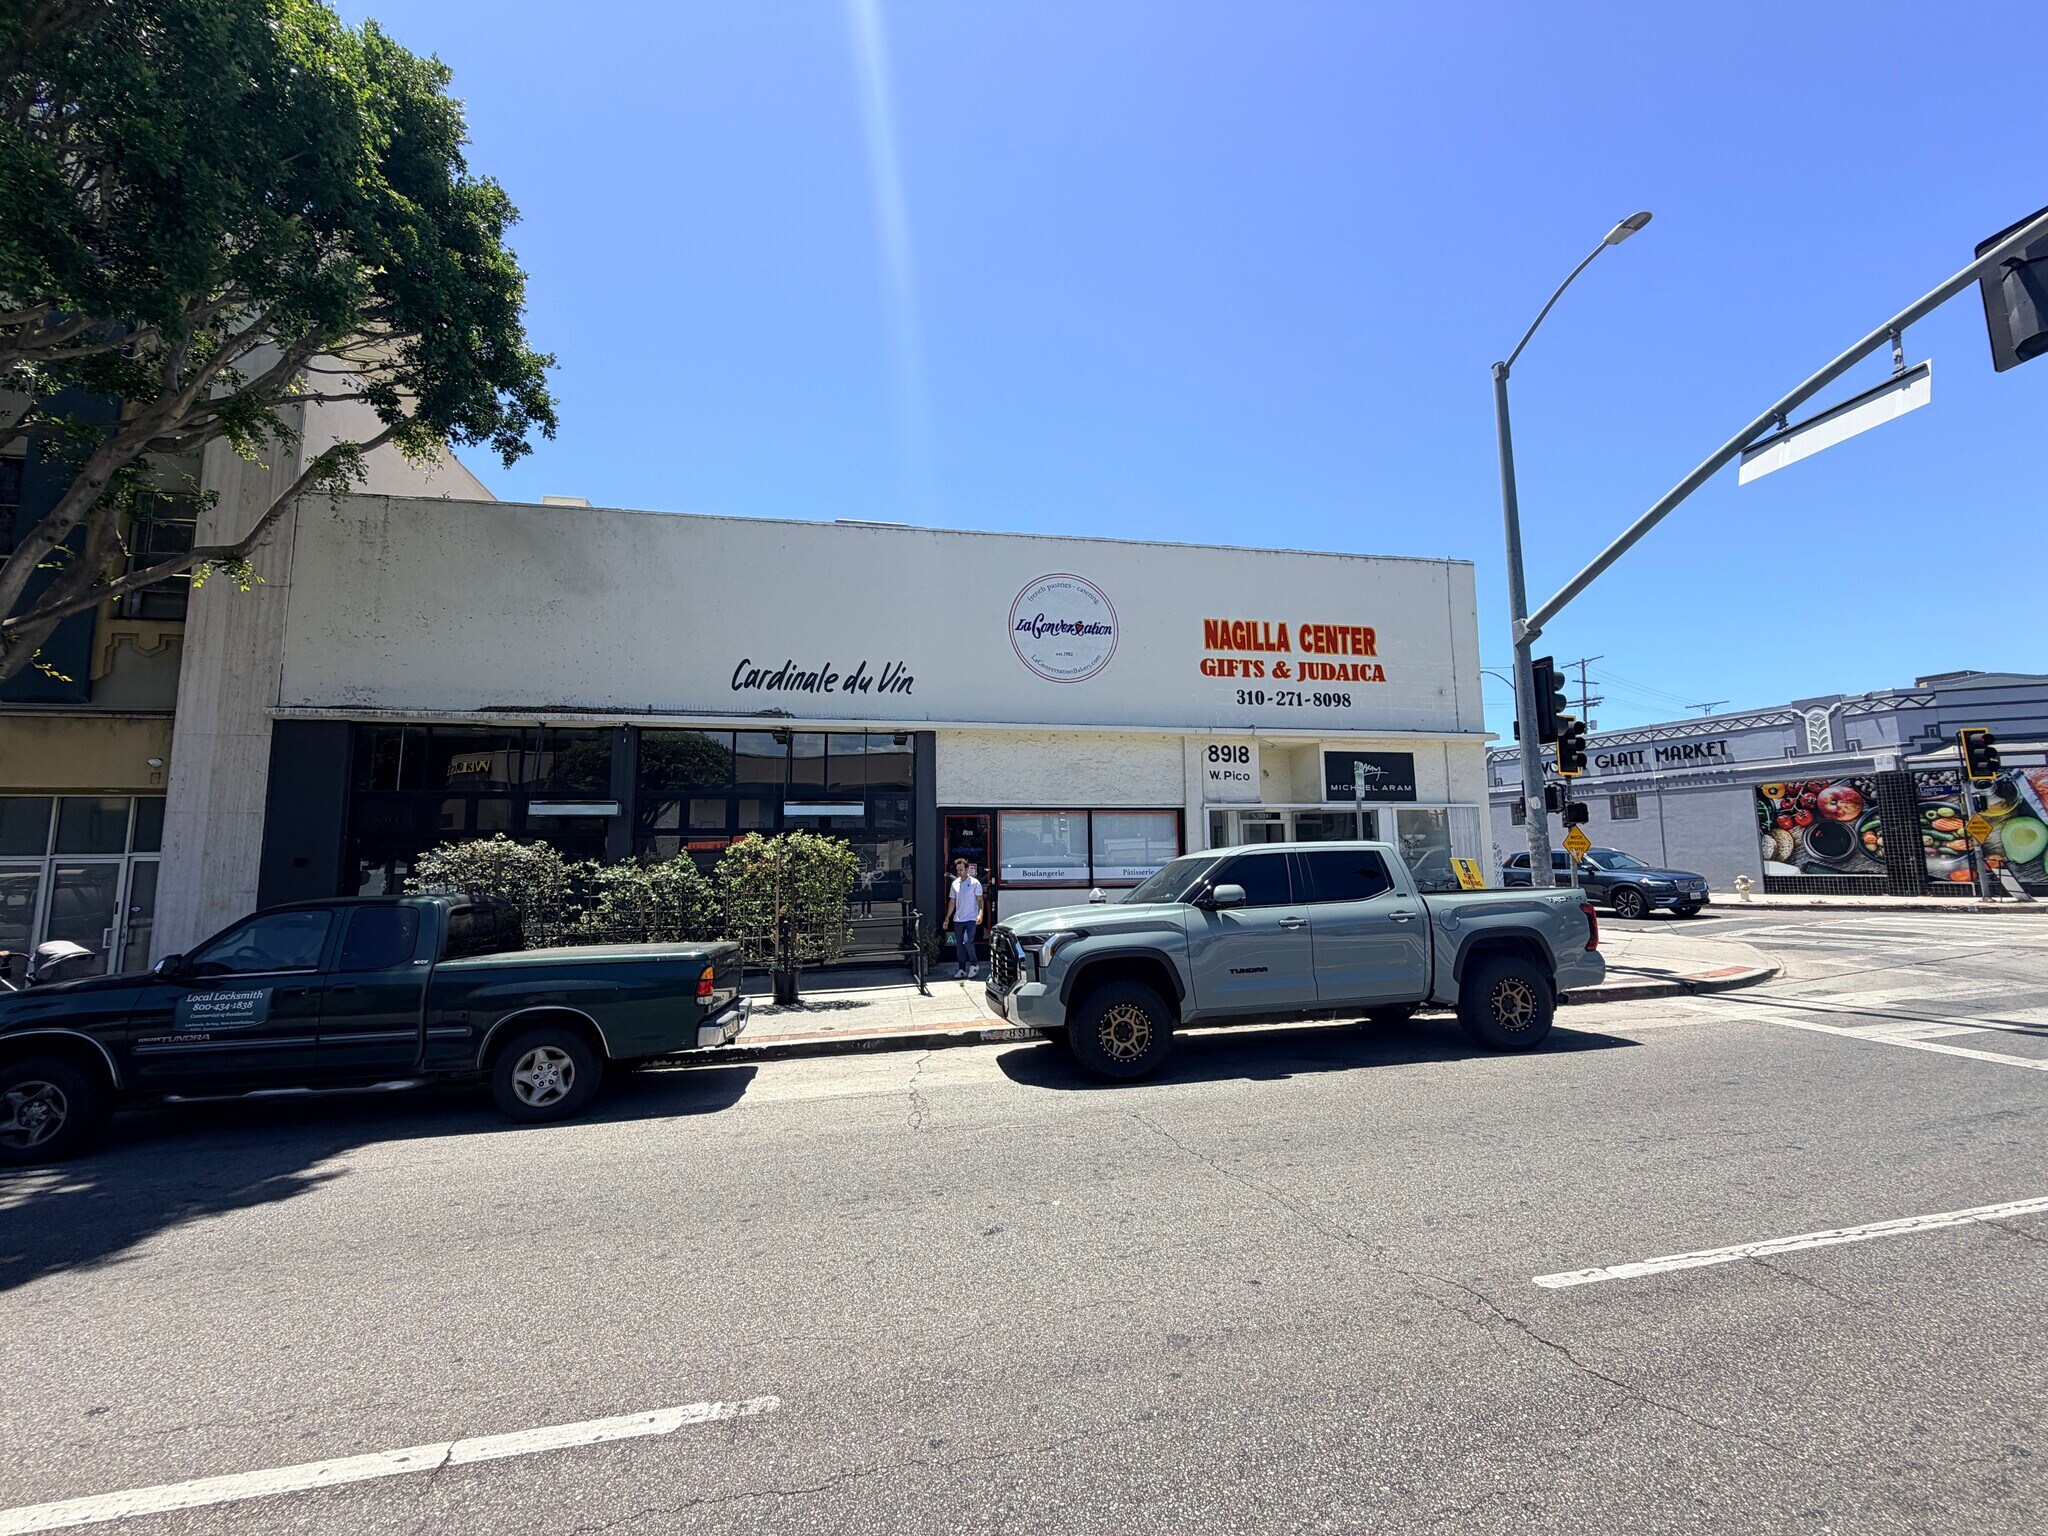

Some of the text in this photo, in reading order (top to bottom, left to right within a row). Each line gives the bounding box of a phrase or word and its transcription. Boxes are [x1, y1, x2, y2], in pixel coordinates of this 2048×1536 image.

[1077, 586, 1100, 605] catering
[1203, 618, 1378, 657] NAGILLA CENTER
[1200, 658, 1387, 682] GIFTS & JUDAICA
[731, 658, 915, 695] Cardinale du Vin
[1236, 689, 1352, 707] 310-271-8098
[1208, 744, 1250, 764] 8918
[1594, 740, 1728, 769] GLATT MARKET
[1209, 770, 1250, 781] W. Pico
[1330, 784, 1412, 792] MICHEL ARAM
[1022, 870, 1065, 878] Boulangerie
[946, 934, 955, 943] A
[1229, 966, 1268, 974] TUNDRA
[186, 990, 263, 1002] Local Locksmith
[192, 1001, 254, 1012] 800-434-1838
[160, 1033, 210, 1042] TUNDRA
